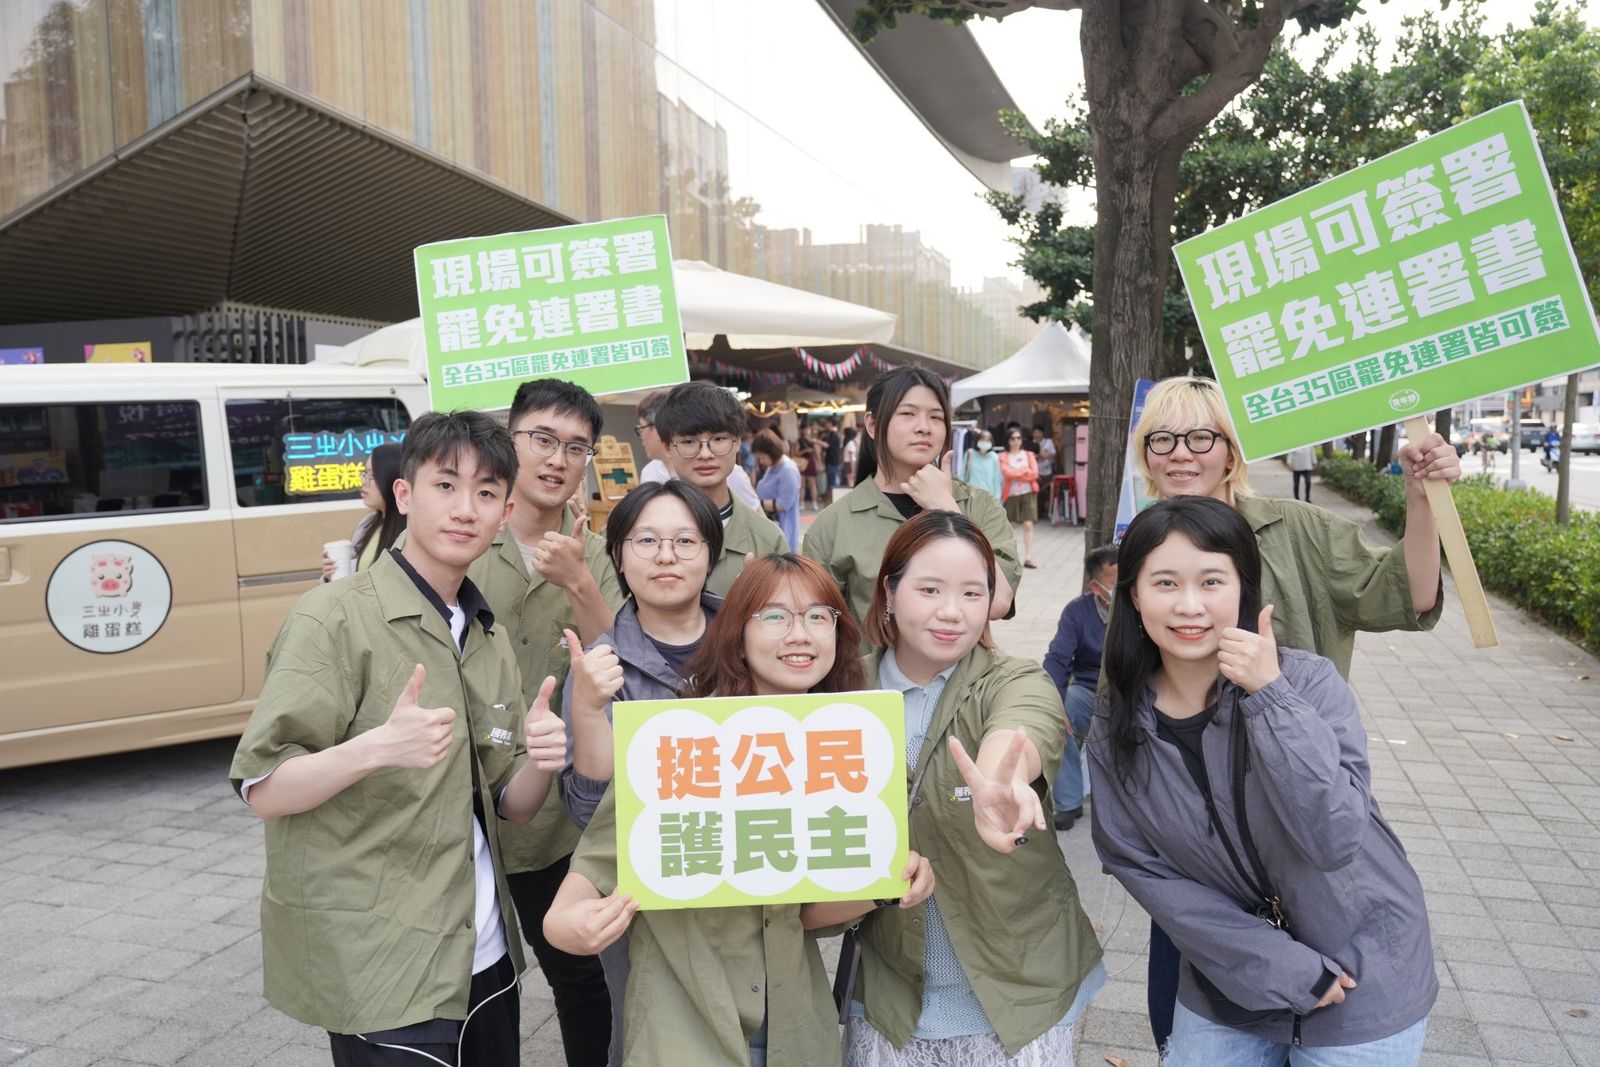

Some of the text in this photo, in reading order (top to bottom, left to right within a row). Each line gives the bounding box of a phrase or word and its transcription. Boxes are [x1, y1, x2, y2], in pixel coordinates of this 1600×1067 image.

[1196, 133, 1522, 310] 現場可簽署
[430, 230, 657, 298] 現場可簽署
[1220, 219, 1547, 379] 罷免連署書
[436, 285, 664, 353] 罷免連署書
[444, 338, 670, 387] 全台35區罷免連署皆可簽
[1246, 300, 1566, 420] 全台35區罷免連署皆可簽
[289, 462, 366, 491] 雞蛋糕
[83, 622, 142, 638] 雞蛋糕
[656, 729, 869, 801] 挺公民
[659, 805, 871, 878] 護民主
